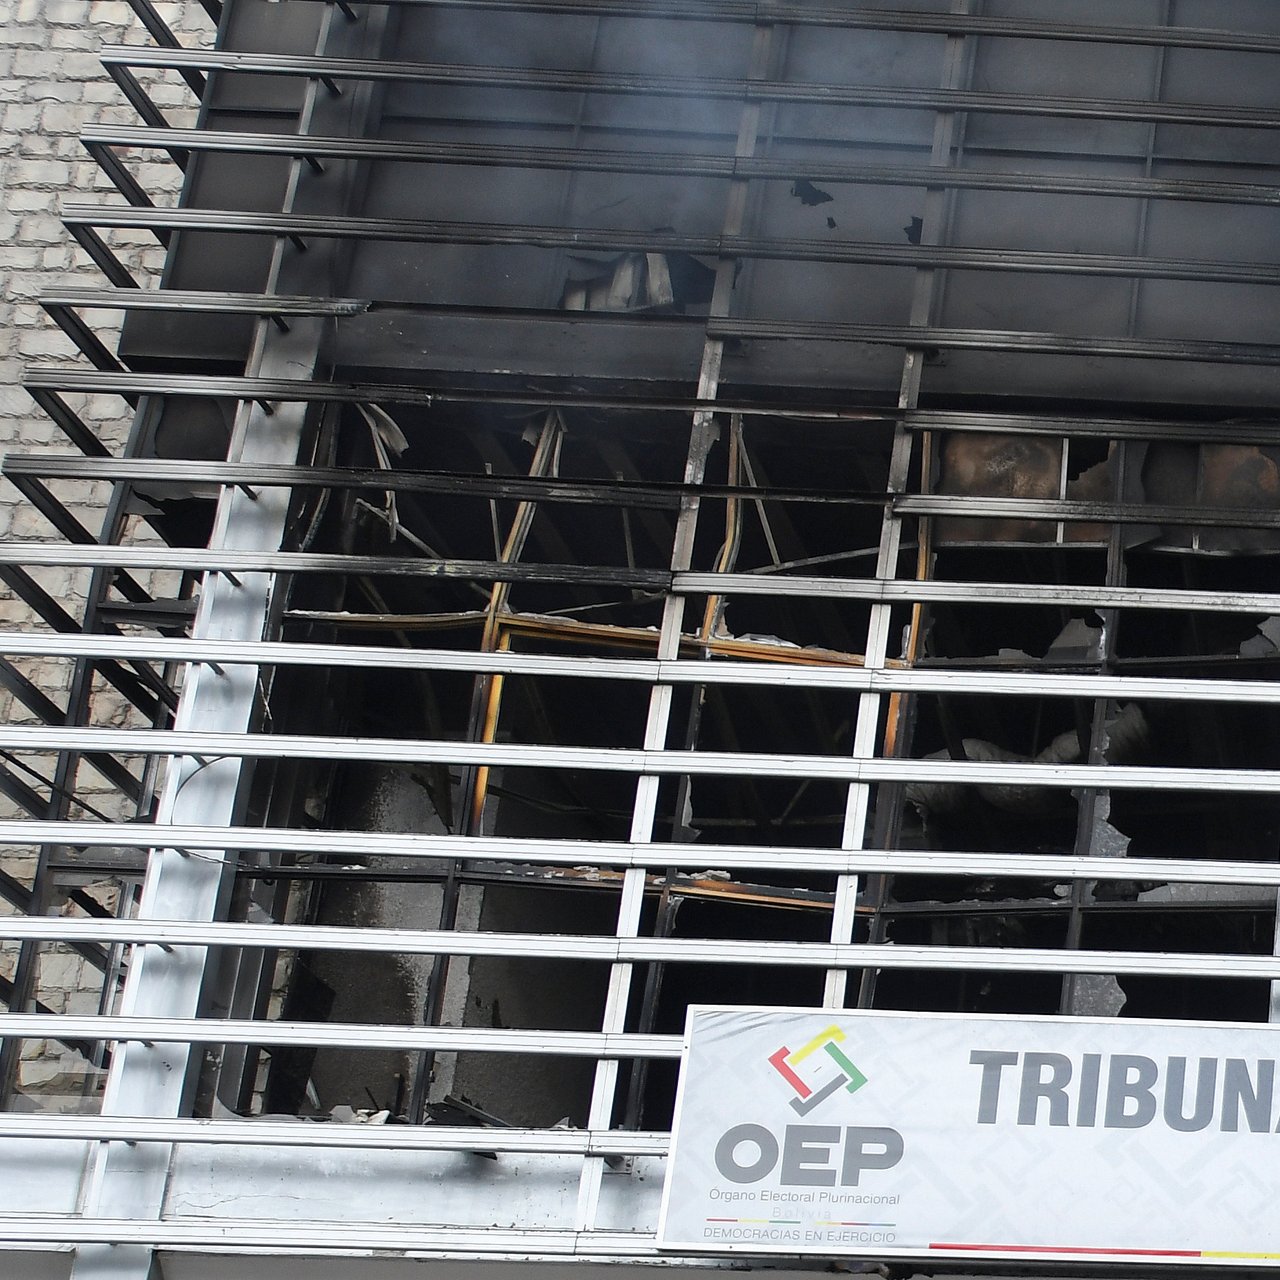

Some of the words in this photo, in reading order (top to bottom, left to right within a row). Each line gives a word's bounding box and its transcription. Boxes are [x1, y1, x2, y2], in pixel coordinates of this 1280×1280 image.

[714, 1123, 905, 1187] OEP
[709, 1186, 756, 1203] Órgano
[760, 1189, 815, 1203] Electoral
[819, 1191, 901, 1205] Plurinacional
[772, 1206, 832, 1220] Bolivia
[703, 1227, 801, 1241] DEMOCRACIAS
[804, 1230, 823, 1241] EN
[826, 1230, 896, 1243] EJERCICIO
